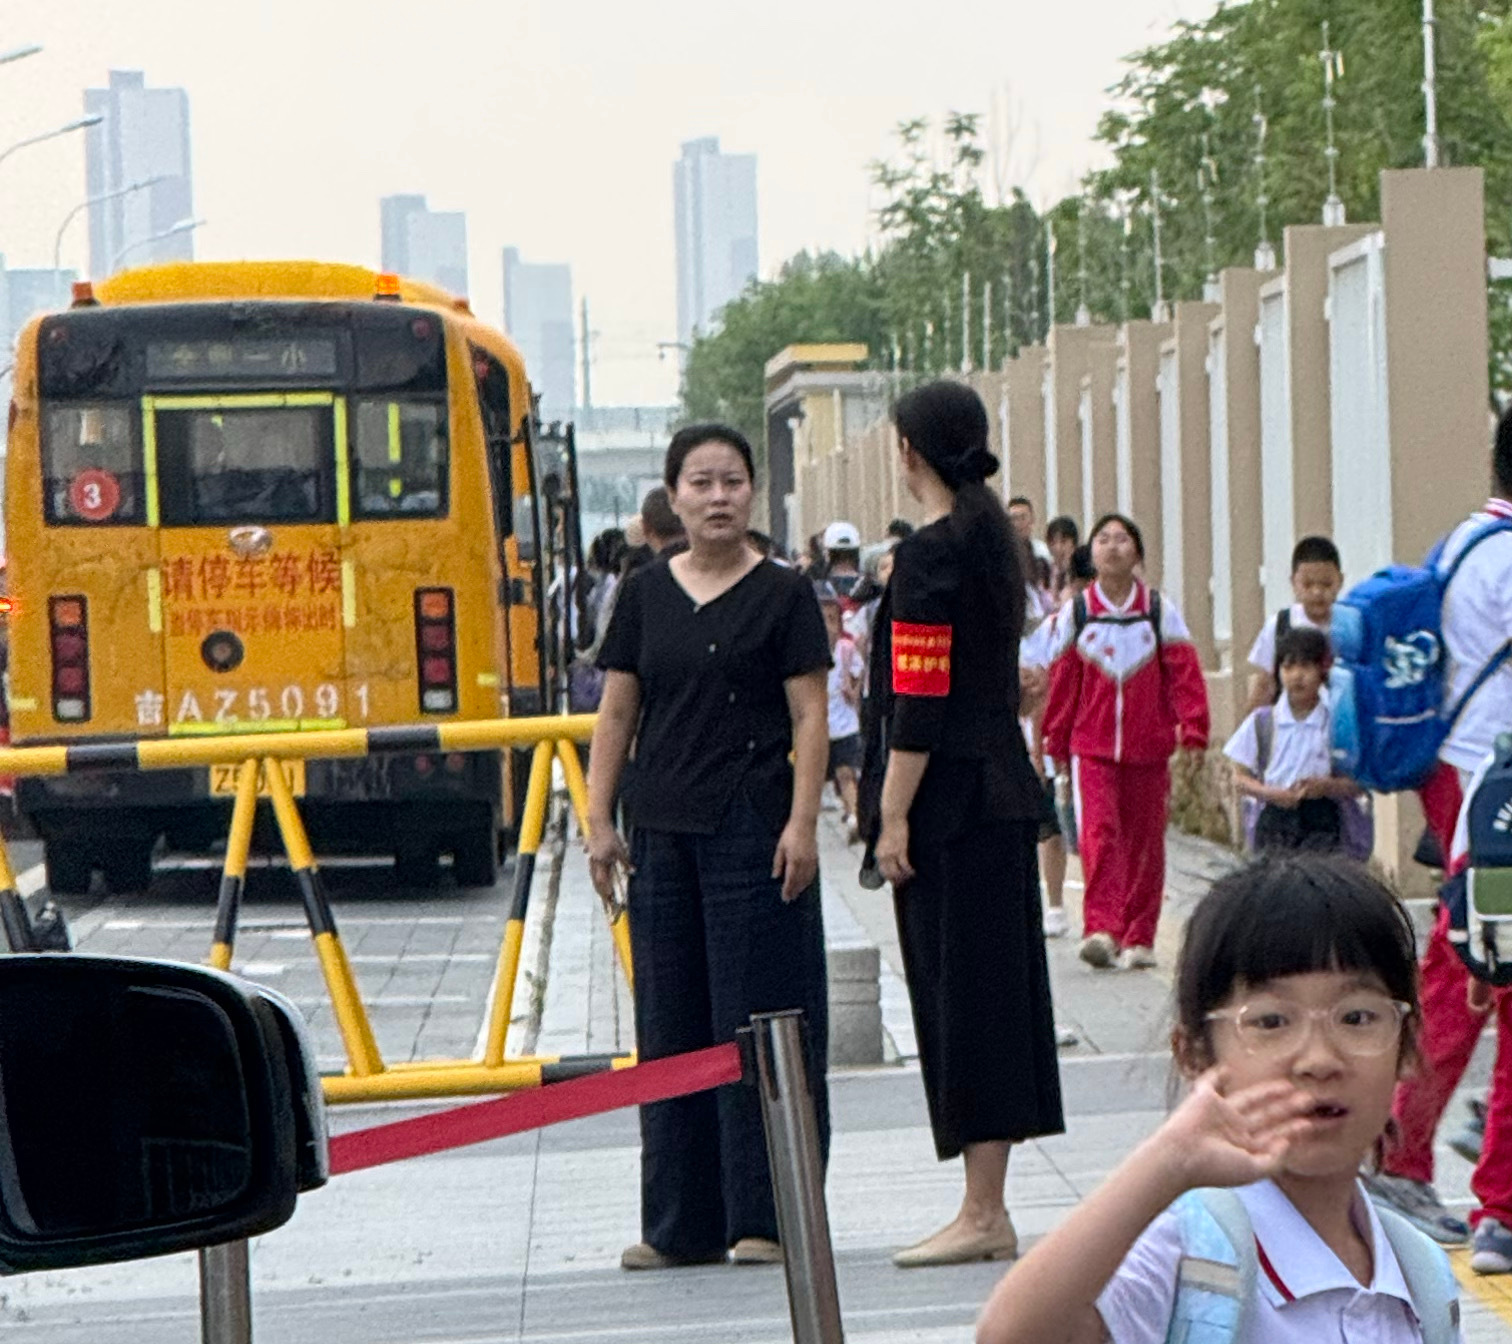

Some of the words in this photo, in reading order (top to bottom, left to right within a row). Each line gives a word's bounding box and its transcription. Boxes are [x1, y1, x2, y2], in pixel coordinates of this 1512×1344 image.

[83, 483, 102, 509] 3
[162, 551, 341, 600] 请停车等候
[134, 683, 369, 726] 吉AZ5091
